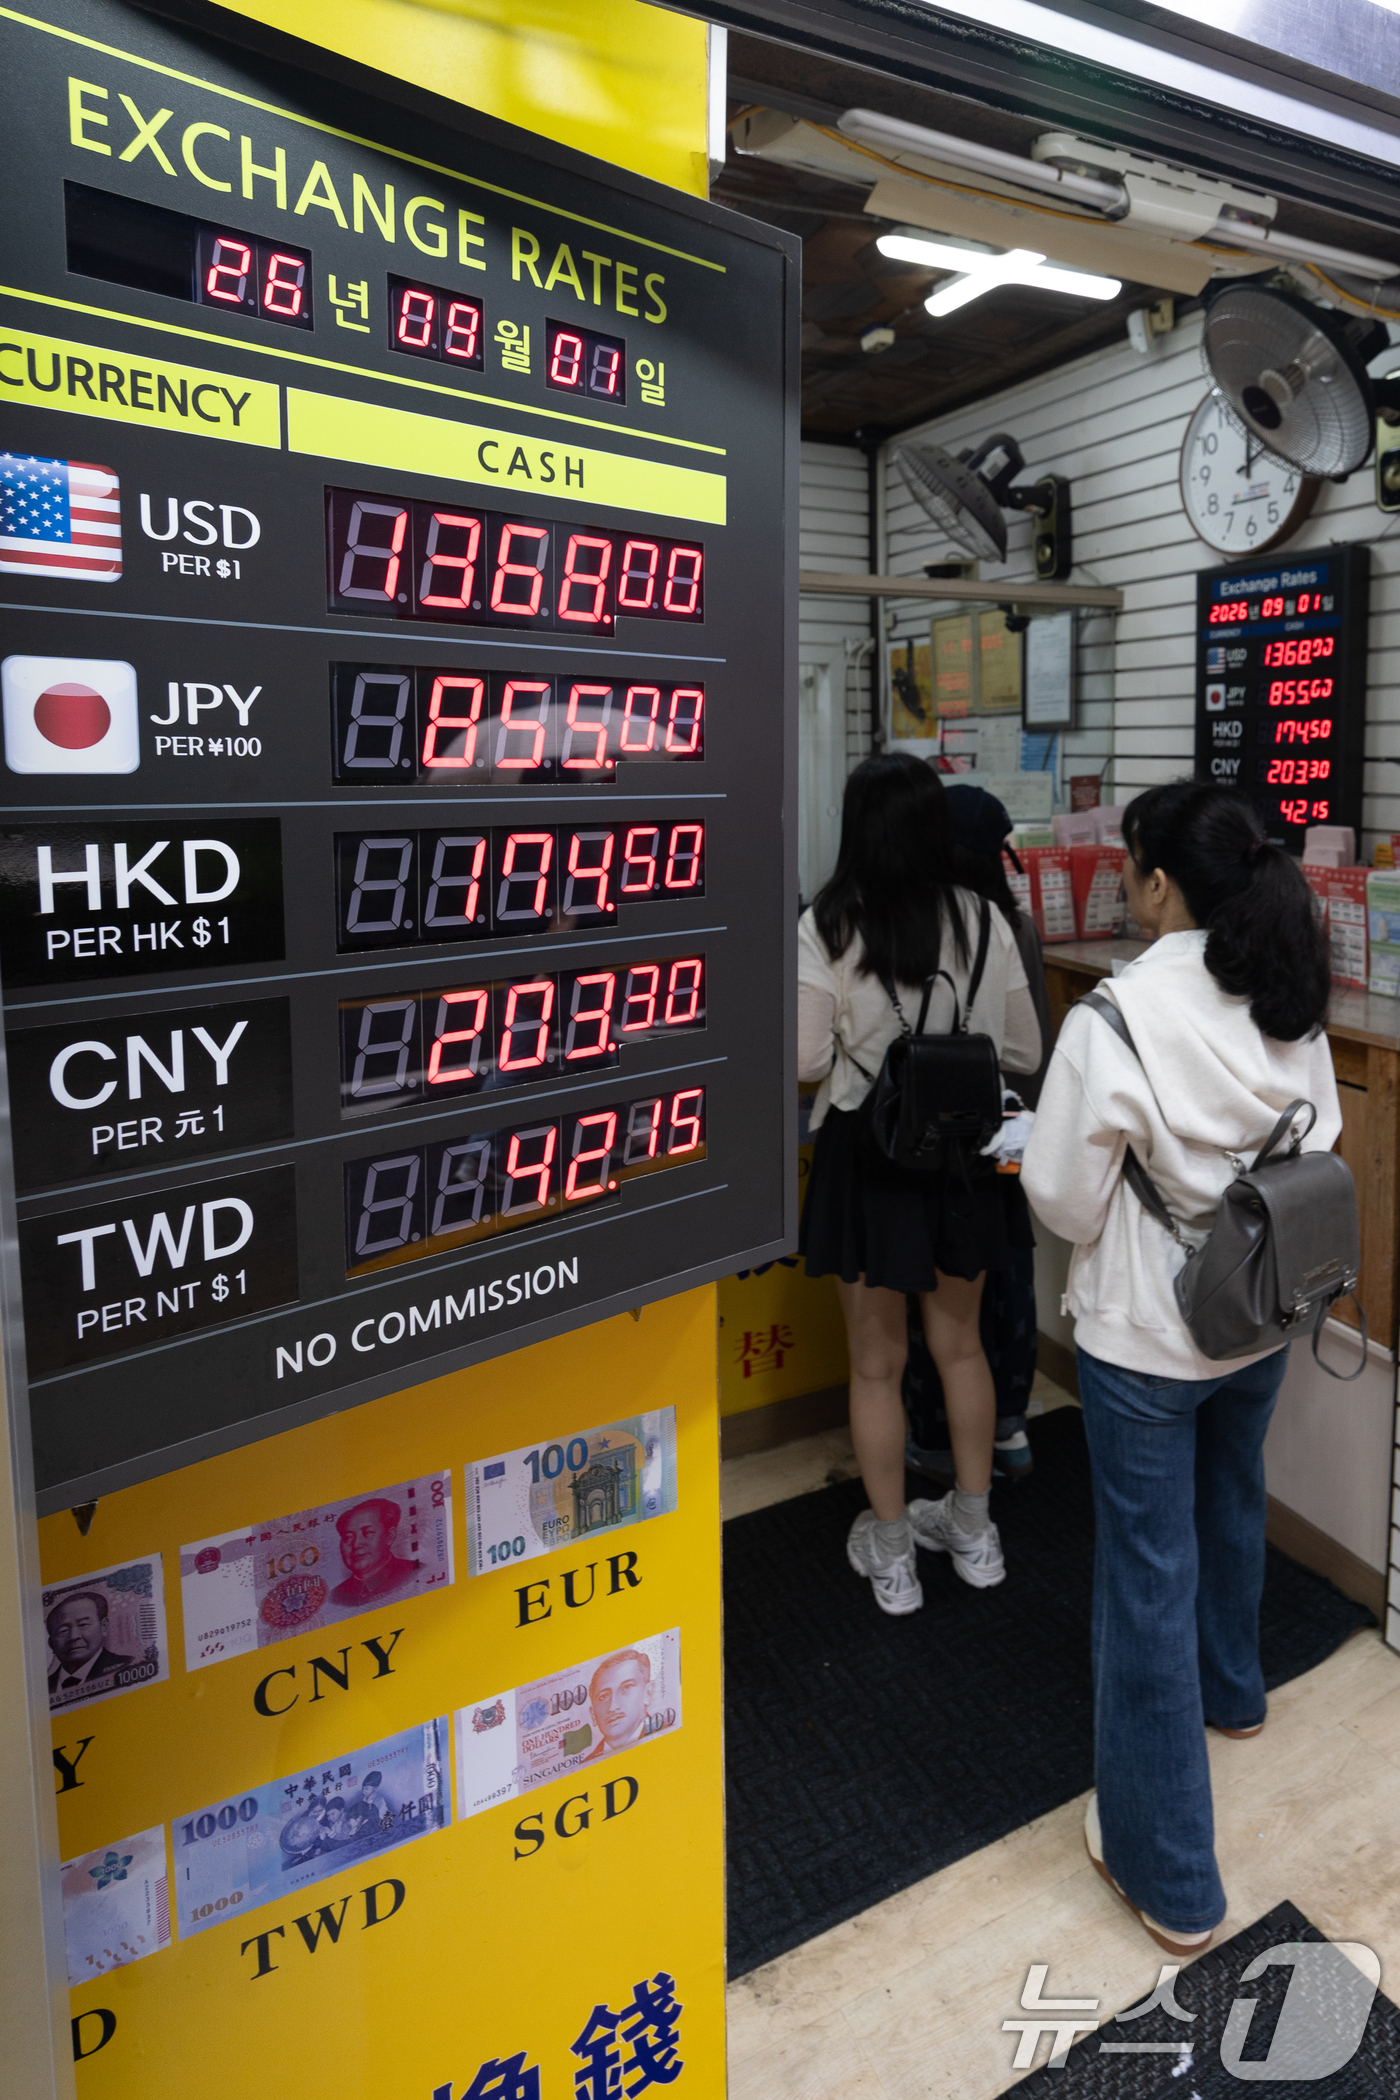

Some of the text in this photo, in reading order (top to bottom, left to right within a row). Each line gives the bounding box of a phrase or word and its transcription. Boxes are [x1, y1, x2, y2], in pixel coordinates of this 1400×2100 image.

[68, 76, 668, 324] EXCHANGE RATES
[207, 238, 665, 407] 26 년 09 월 01 일
[0, 343, 251, 426] CURRENCY
[477, 440, 585, 488] CASH
[1200, 465, 1212, 486] 9
[1207, 493, 1220, 515] 8
[1283, 475, 1296, 496] 4
[140, 494, 260, 549] USD
[1223, 511, 1235, 534] 7
[1245, 516, 1257, 536] 6
[1267, 501, 1279, 524] 5
[162, 553, 240, 580] PER $1
[384, 511, 703, 625] 1368.00
[1220, 570, 1318, 597] Exchange Rates
[1209, 602, 1248, 623] 2026
[1261, 597, 1284, 617] 09
[1297, 593, 1321, 613] 01
[1226, 647, 1248, 661] USD
[150, 682, 263, 727] JPY
[1226, 686, 1247, 700] JPY
[422, 676, 703, 769] 855.00
[1212, 720, 1243, 738] HKD
[155, 736, 262, 757] PER ¥100
[1210, 757, 1242, 776] CNY
[37, 839, 241, 914] HKD
[465, 825, 703, 918] 174.50
[47, 916, 229, 960] PER HK $1
[427, 959, 703, 1085] 203.30
[49, 1020, 249, 1110] CNY
[92, 1105, 224, 1155] PER 元 1
[507, 1088, 703, 1207] 42.15
[57, 1197, 254, 1292] TWD
[77, 1269, 246, 1339] PER NT $1
[276, 1256, 579, 1379] NO COMMISSION
[523, 1437, 589, 1484] 100
[542, 1514, 570, 1531] EURO
[266, 1546, 320, 1580] 100
[486, 1536, 526, 1565] 100
[514, 1549, 642, 1628] EUR
[118, 1663, 155, 1685] 10000
[253, 1628, 405, 1717] CNY
[550, 1684, 588, 1716] 100
[541, 1719, 581, 1741] HUNDRED
[643, 1708, 676, 1736] 100
[284, 1763, 352, 1798] 中華民國
[523, 1753, 585, 1786] SINGAPORE
[181, 1796, 259, 1847] 1000
[514, 1774, 639, 1861] SGD
[189, 1891, 244, 1924] 1000
[241, 1878, 406, 1981] TWD
